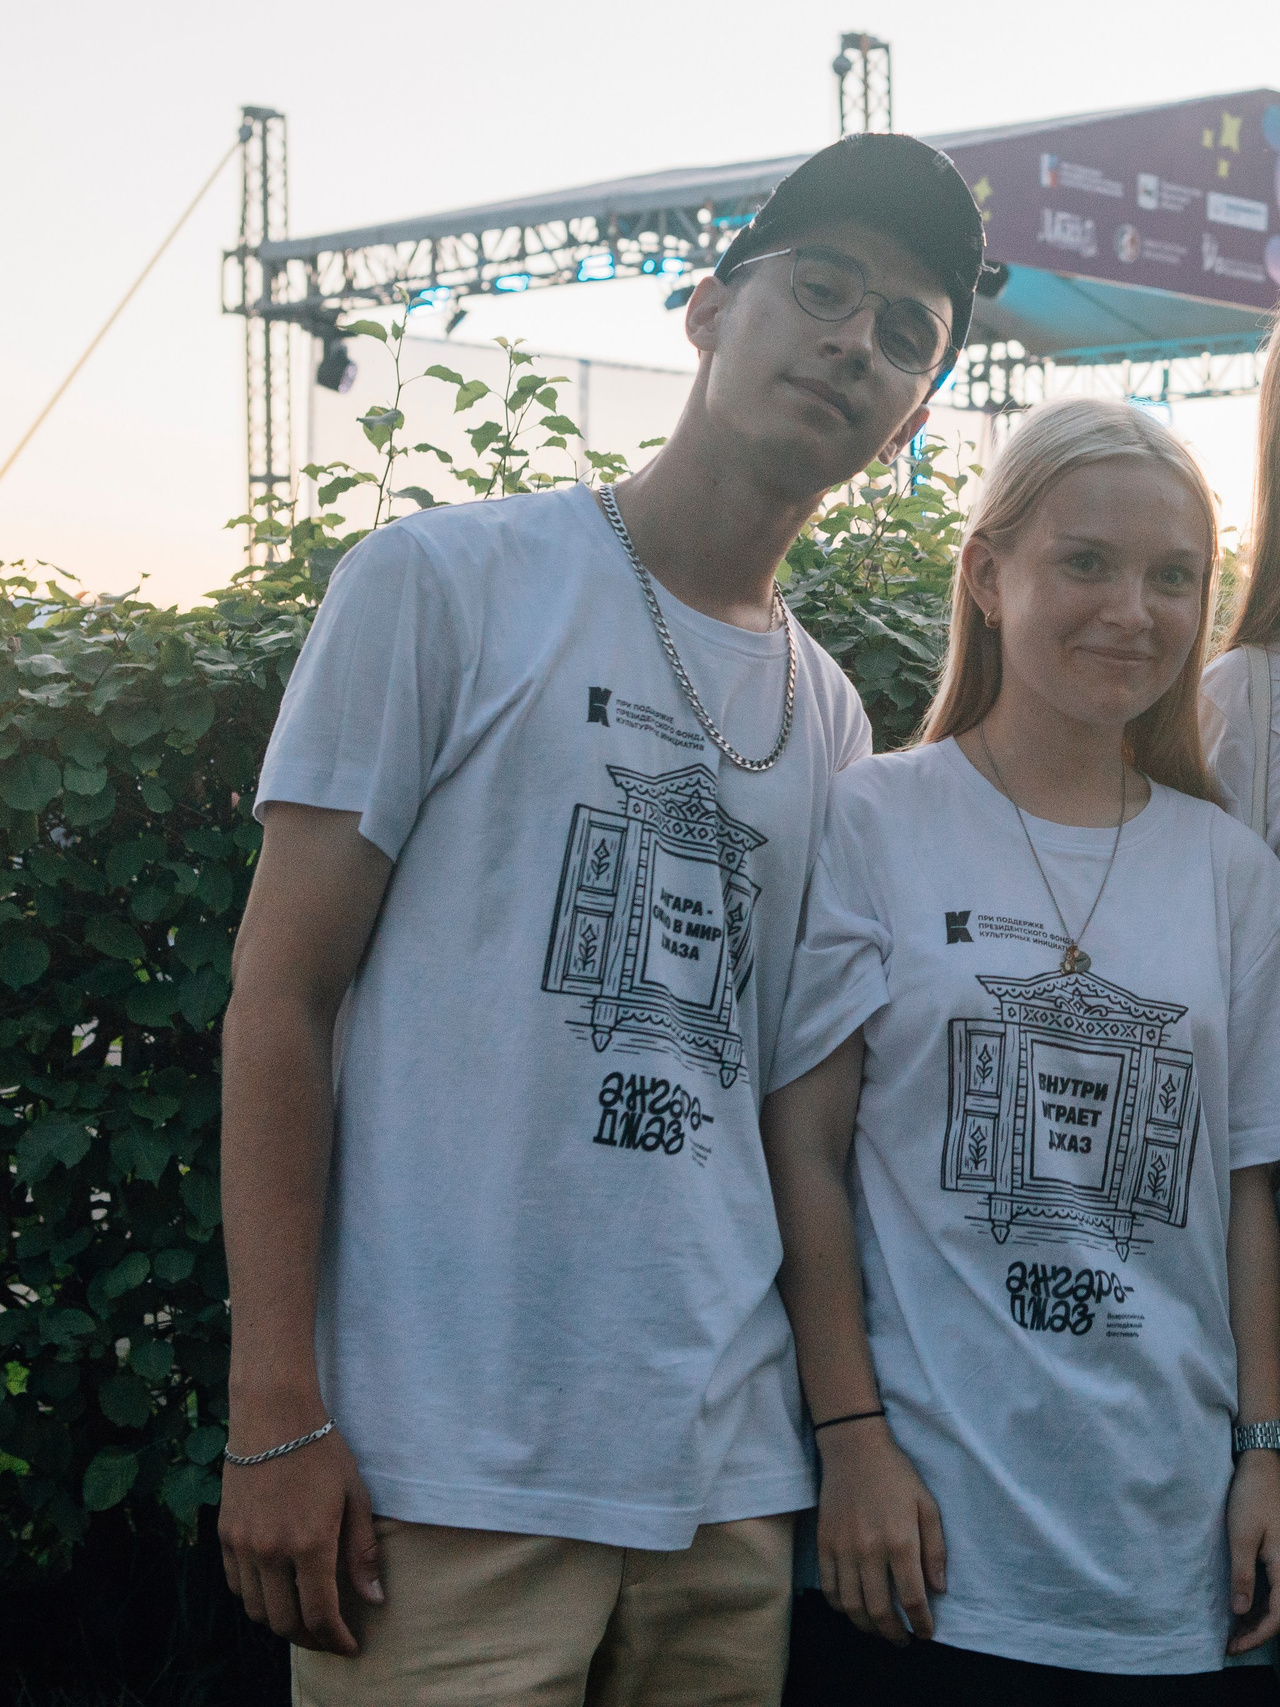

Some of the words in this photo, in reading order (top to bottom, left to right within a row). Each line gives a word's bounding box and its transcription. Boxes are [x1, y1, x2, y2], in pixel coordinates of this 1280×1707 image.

[615, 698, 632, 708] ПРИ
[675, 730, 705, 743] ФОНДА
[673, 918, 683, 934] В
[685, 921, 723, 942] МИР
[978, 922, 1047, 938] ПРЕЗИДЕНТСКОГО
[996, 916, 1044, 930] ПОДДЕРЖКЕ
[979, 930, 1031, 942] КУЛЬТУРНЫХ
[1032, 938, 1069, 951] ИНИЦИАТ
[1038, 1072, 1109, 1101] ВНУТРИ
